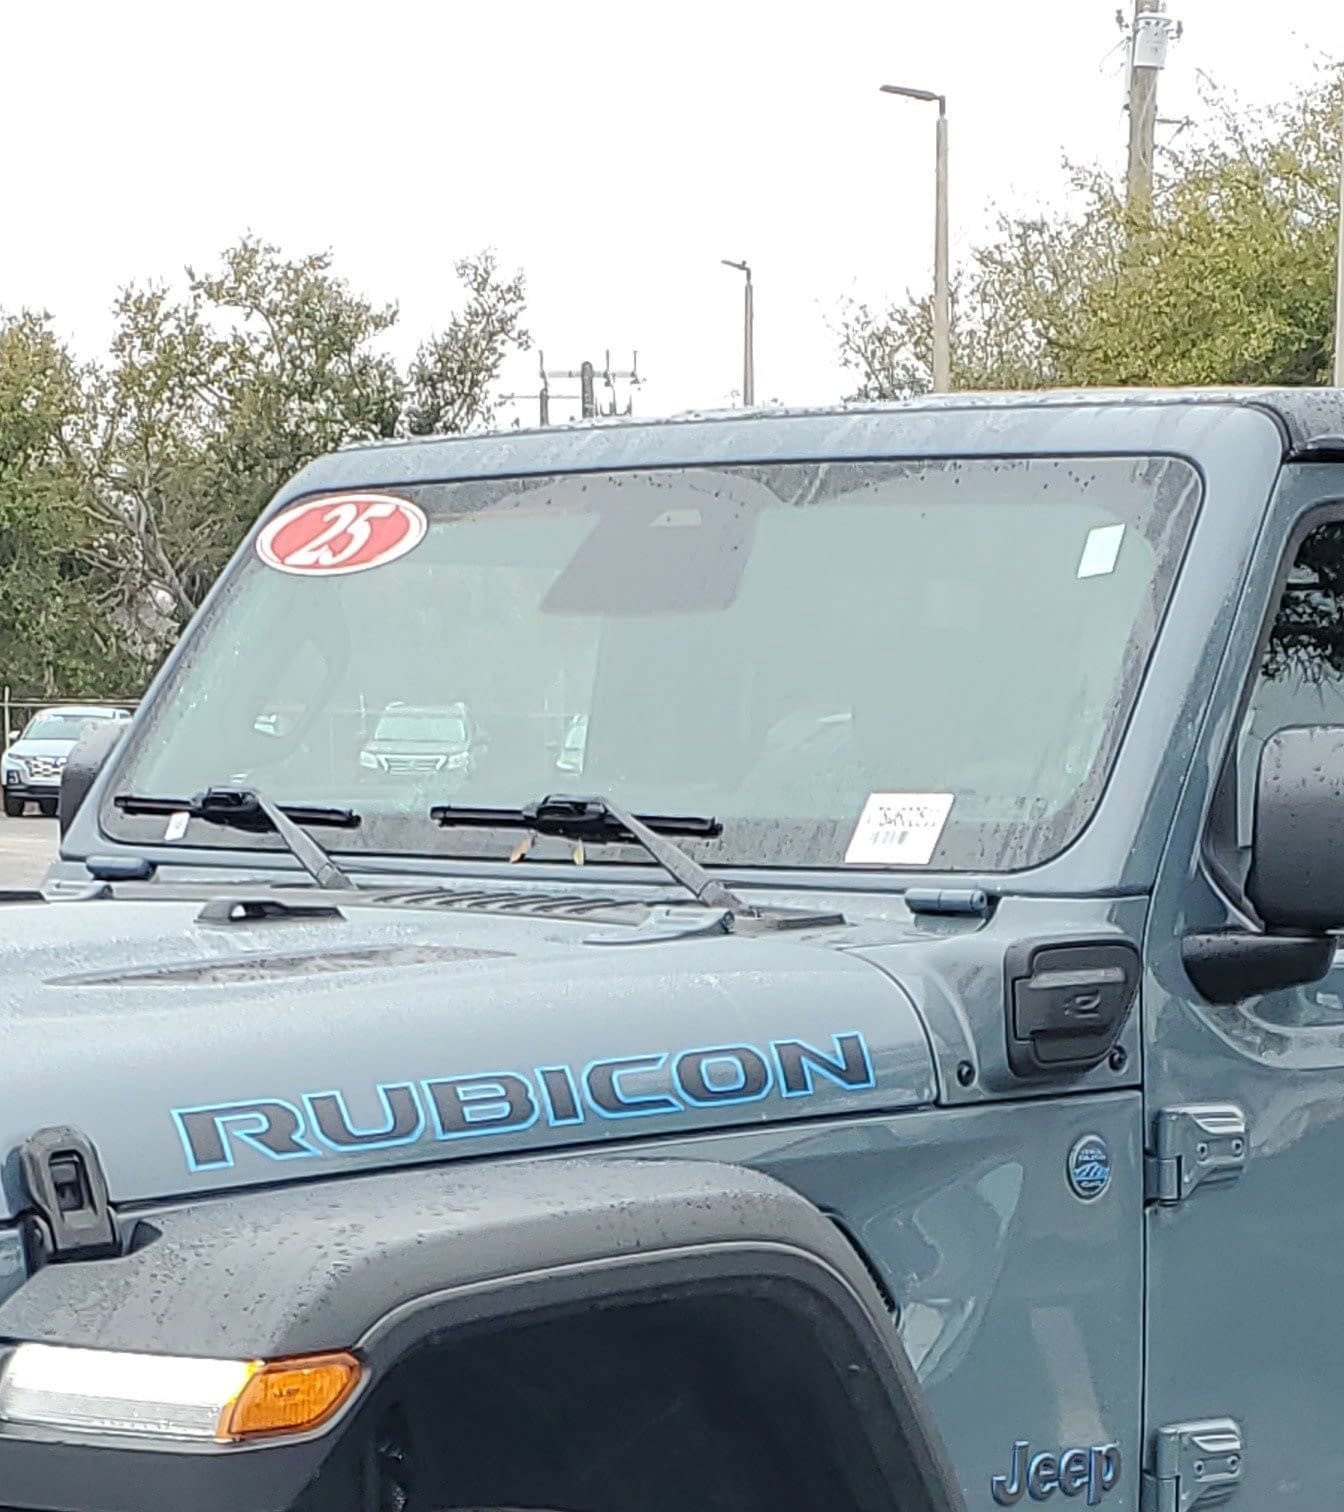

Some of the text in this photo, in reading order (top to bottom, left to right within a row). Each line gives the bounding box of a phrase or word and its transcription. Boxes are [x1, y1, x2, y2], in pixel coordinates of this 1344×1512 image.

[283, 502, 397, 566] 25
[170, 1031, 876, 1173] RUBICON
[991, 1440, 1122, 1507] Jeep
